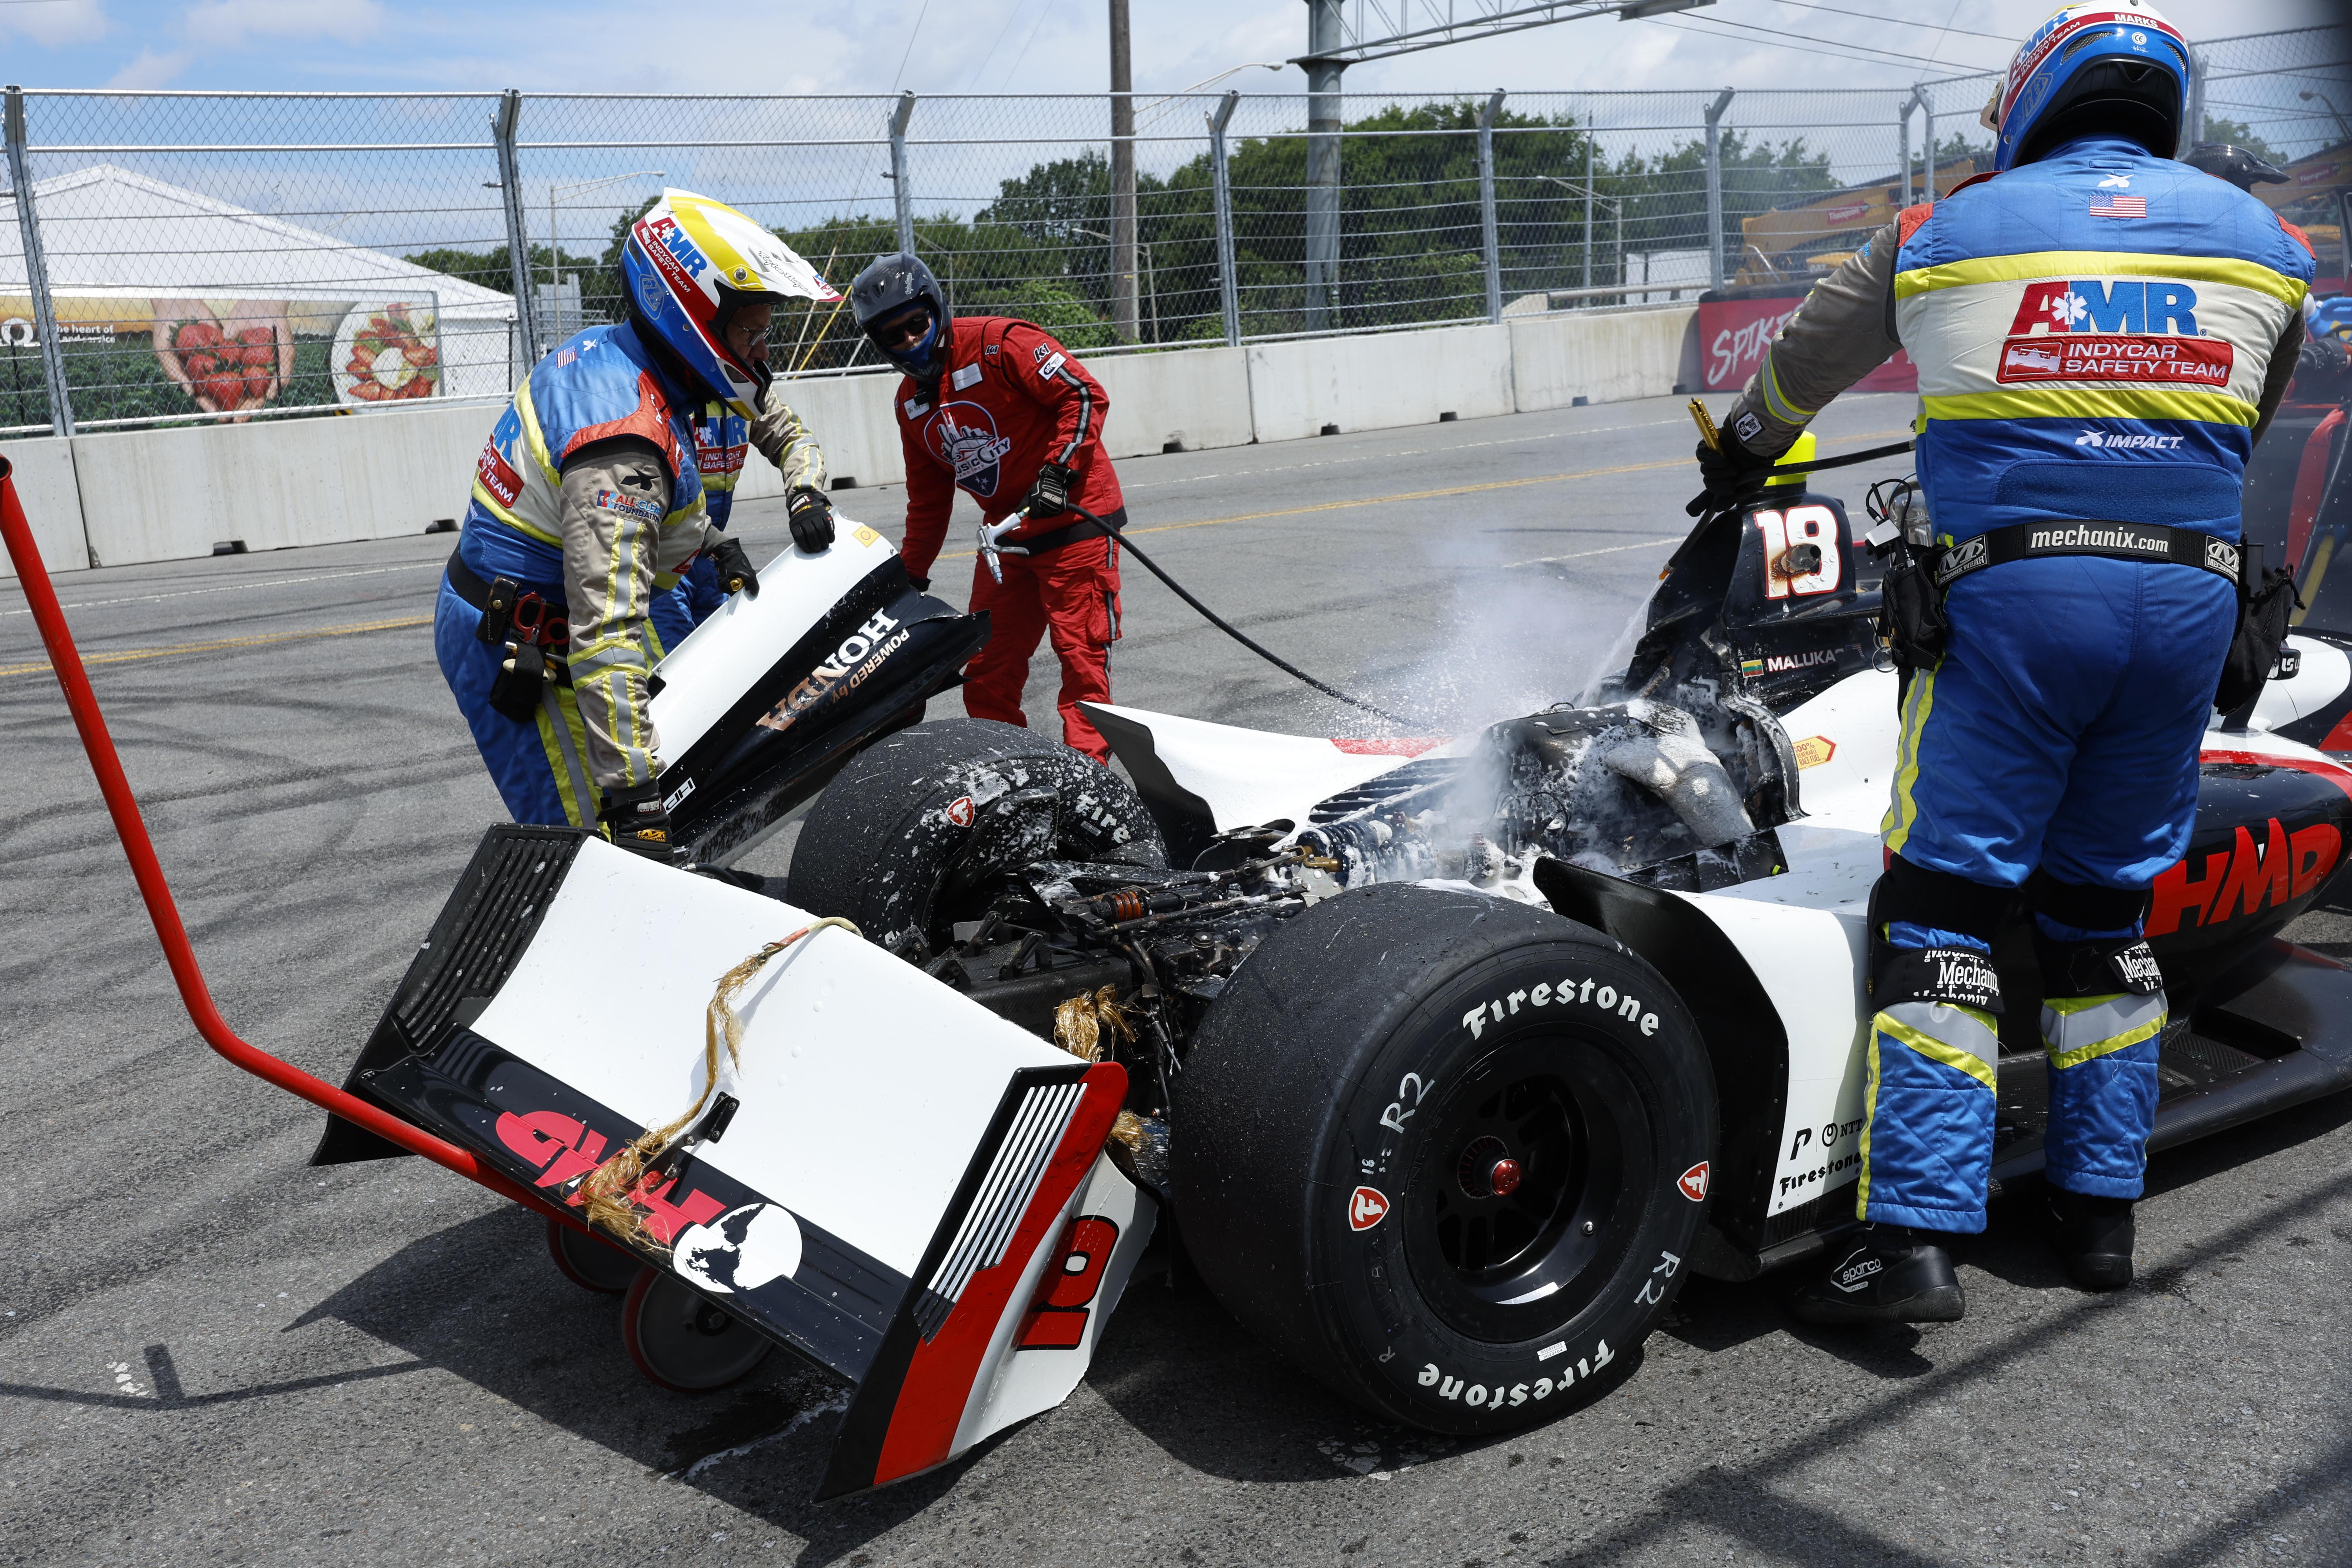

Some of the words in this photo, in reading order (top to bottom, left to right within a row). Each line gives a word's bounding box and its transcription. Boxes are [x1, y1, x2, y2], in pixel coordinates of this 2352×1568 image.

[2114, 14, 2158, 28] MARKS
[2021, 44, 2050, 77] SAFETY
[2052, 21, 2080, 43] TEAM
[2021, 33, 2055, 72] INDYCAR
[650, 217, 707, 279] AMR
[652, 241, 680, 272] INDYCAR
[648, 244, 672, 270] SAFETY
[671, 271, 691, 292] TEAM
[2007, 281, 2198, 336] AMR
[57, 325, 69, 333] he
[72, 324, 101, 334] heart
[103, 325, 114, 334] of
[1033, 343, 1051, 363] K1
[1707, 303, 1804, 386] SPIKE
[2068, 343, 2177, 359] INDYCAR
[2065, 359, 2163, 375] SAFETY
[2171, 362, 2227, 379] TEAM
[2105, 435, 2185, 450] IMPACT
[956, 458, 980, 474] USIC
[485, 470, 514, 503] TEAM
[616, 495, 636, 507] ALL
[614, 503, 660, 524] FOUNDATION
[1754, 505, 1842, 600] 18
[2031, 524, 2168, 553] mechanix.com
[1964, 555, 1985, 570] WEAR
[755, 607, 899, 731] HONDA
[850, 628, 910, 688] POWERED
[1768, 649, 1844, 672] MALUKA
[831, 684, 849, 704] by
[1797, 748, 1817, 758] RENEWABLE
[1799, 757, 1810, 766] RACE
[1809, 754, 1821, 763] FUEL
[666, 780, 693, 811] HP
[2143, 817, 2341, 938] HMD
[1463, 978, 1659, 1040] Firestone
[1379, 1072, 1436, 1134] R2
[1840, 1118, 1863, 1138] NTT
[1779, 1151, 1862, 1197] Firestone
[1634, 1250, 1681, 1305] R2
[1843, 1258, 1881, 1283] sparco
[1543, 1349, 1563, 1359] 2023154
[1417, 1338, 1615, 1411] Firestone
